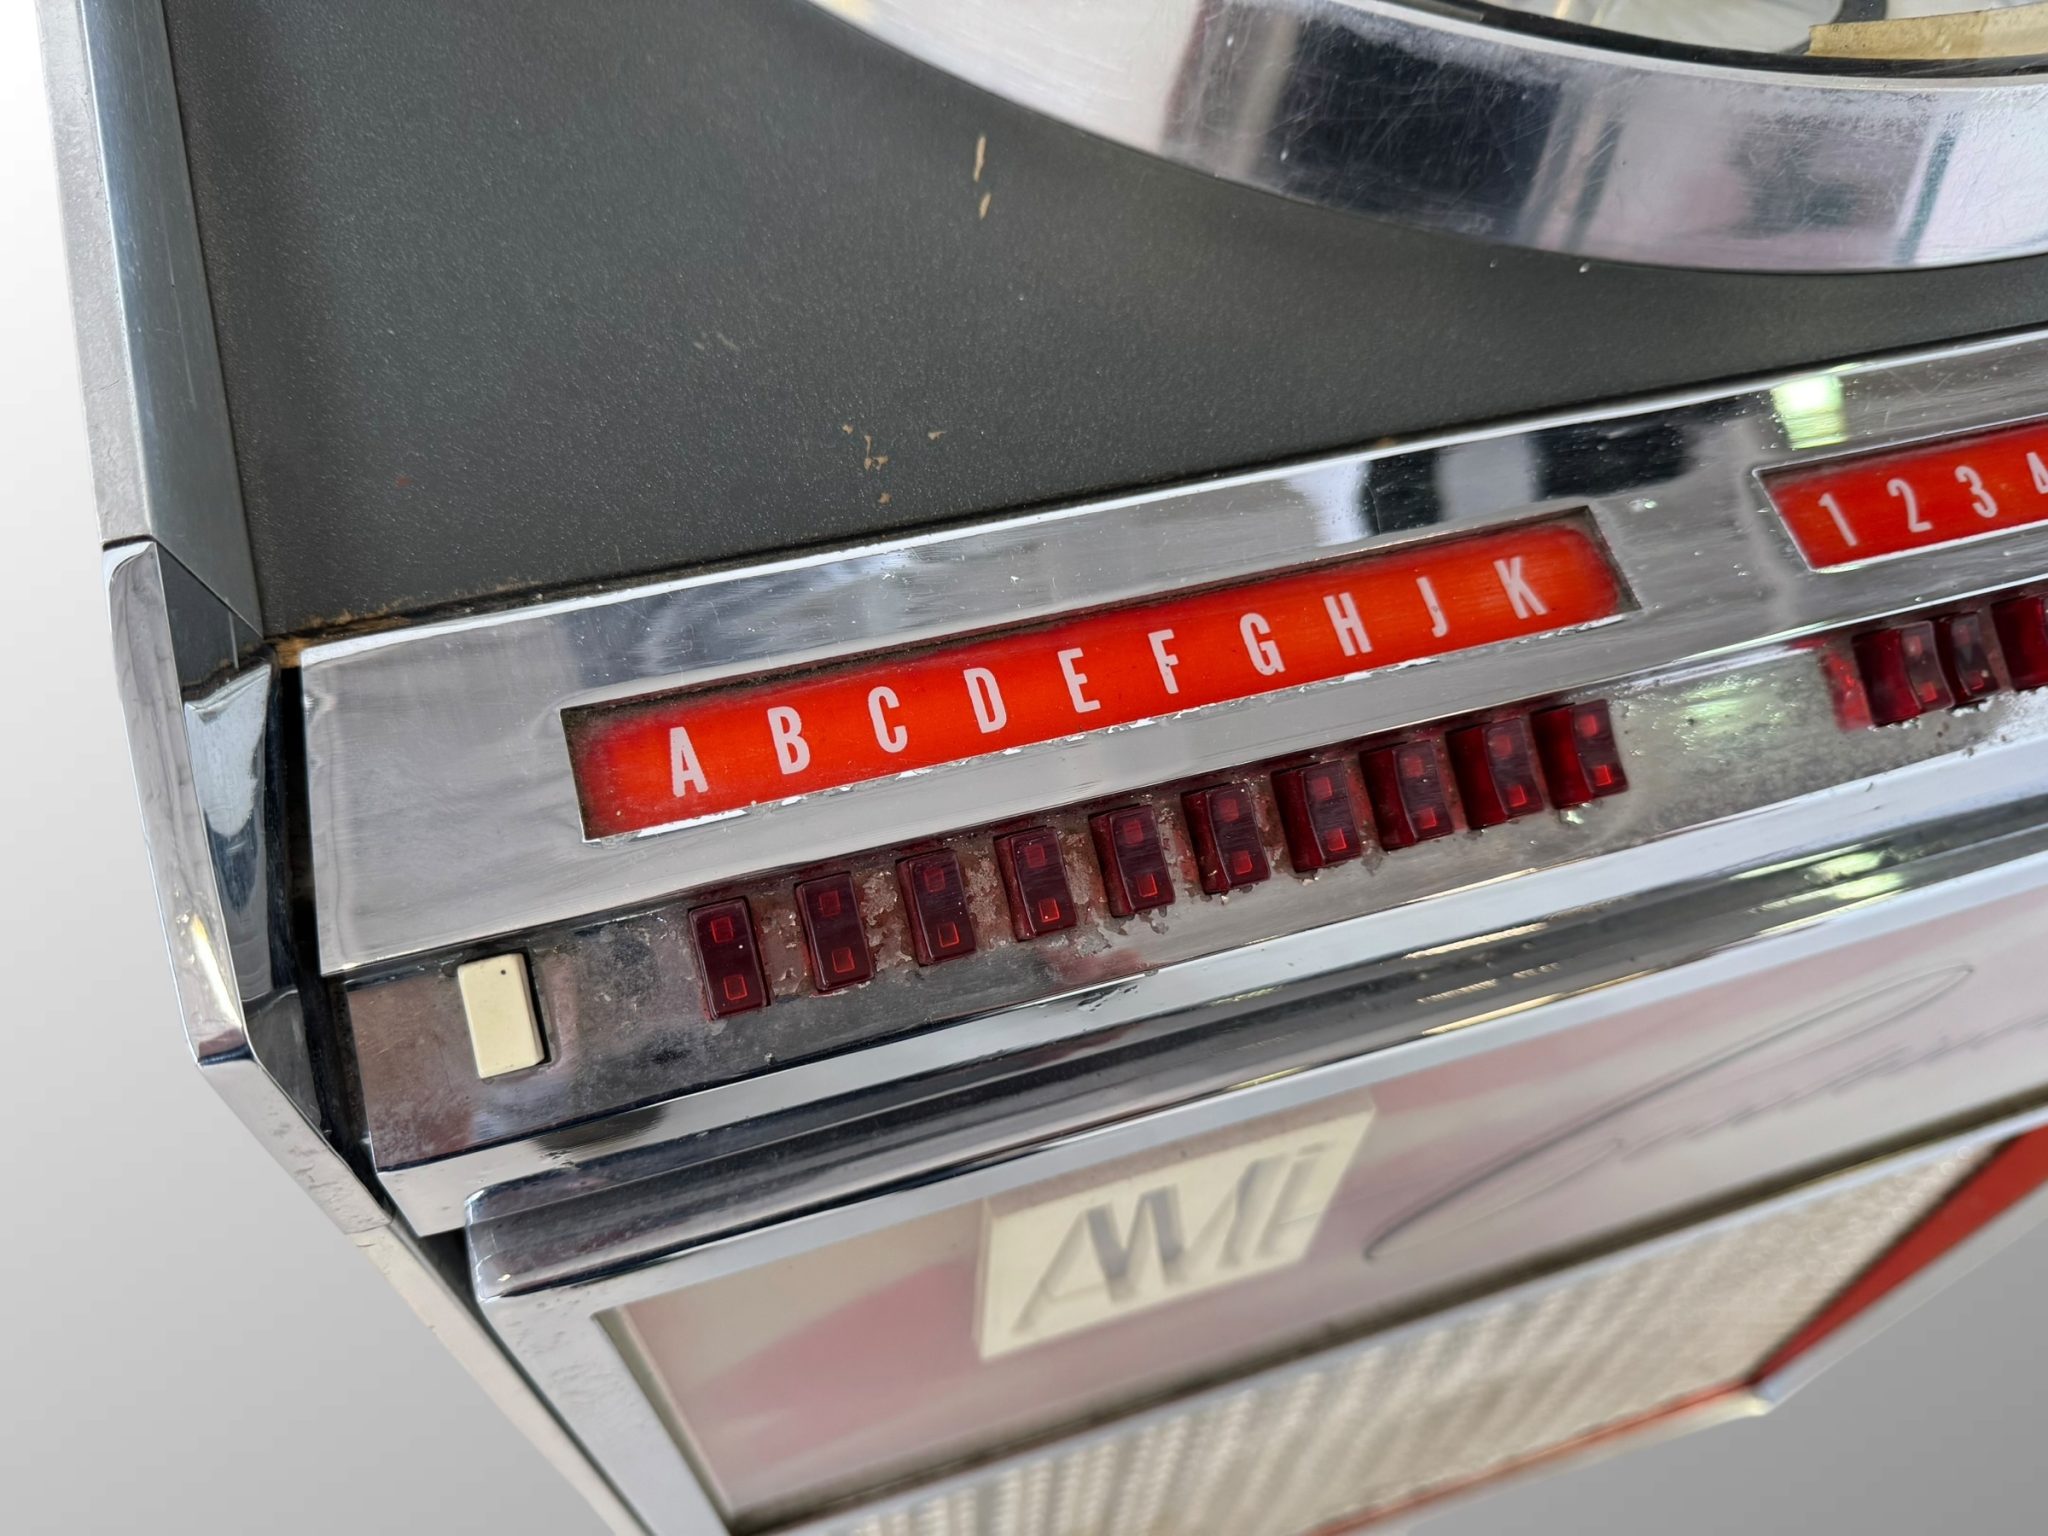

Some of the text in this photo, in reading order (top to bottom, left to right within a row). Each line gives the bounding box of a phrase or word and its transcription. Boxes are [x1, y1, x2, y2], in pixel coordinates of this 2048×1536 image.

[1819, 493, 1858, 546] 1
[1887, 478, 1933, 533] 2
[1955, 465, 1998, 518] 3
[669, 556, 1548, 798] A B C D E F G H J K
